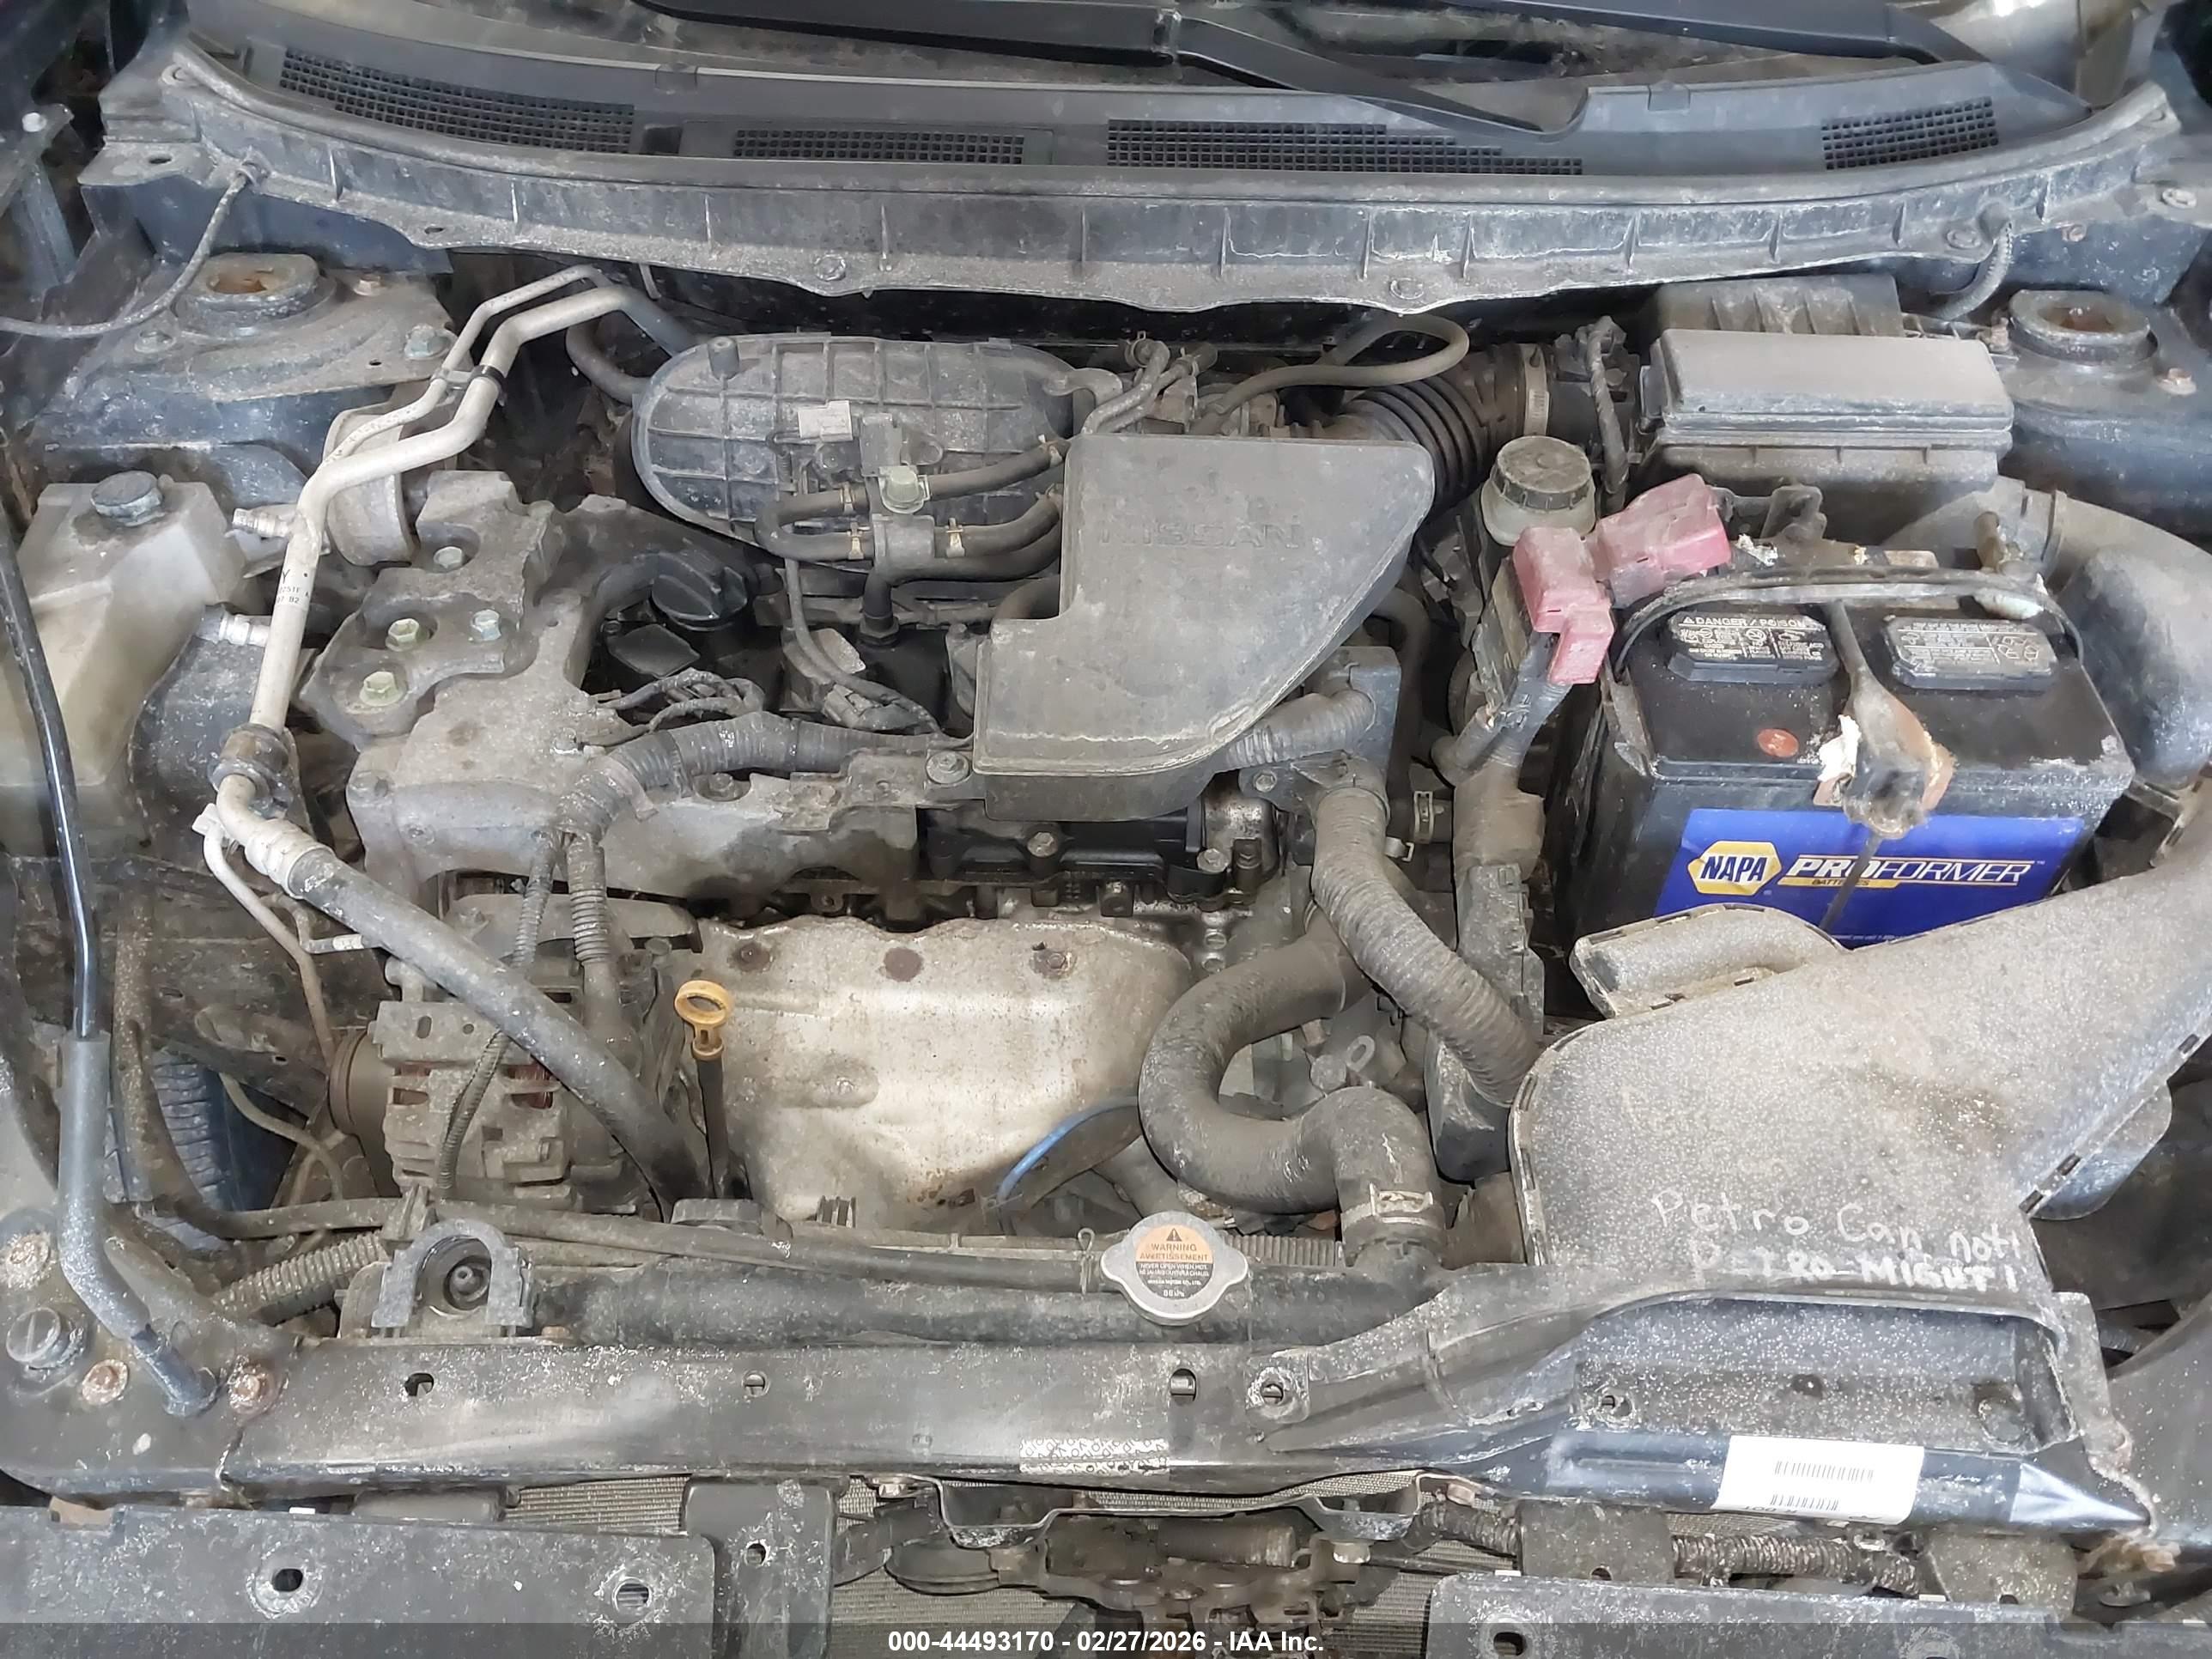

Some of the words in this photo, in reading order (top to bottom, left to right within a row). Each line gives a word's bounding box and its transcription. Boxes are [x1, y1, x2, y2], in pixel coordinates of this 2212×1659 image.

[1695, 617, 1747, 627] DANGER
[1700, 856, 1767, 883] NAPA
[1651, 1189, 1809, 1236] Petro
[1837, 1203, 1922, 1250] Can
[1152, 1243, 1197, 1252] WARNING
[1139, 1252, 1208, 1261] AVERTISSEMENT
